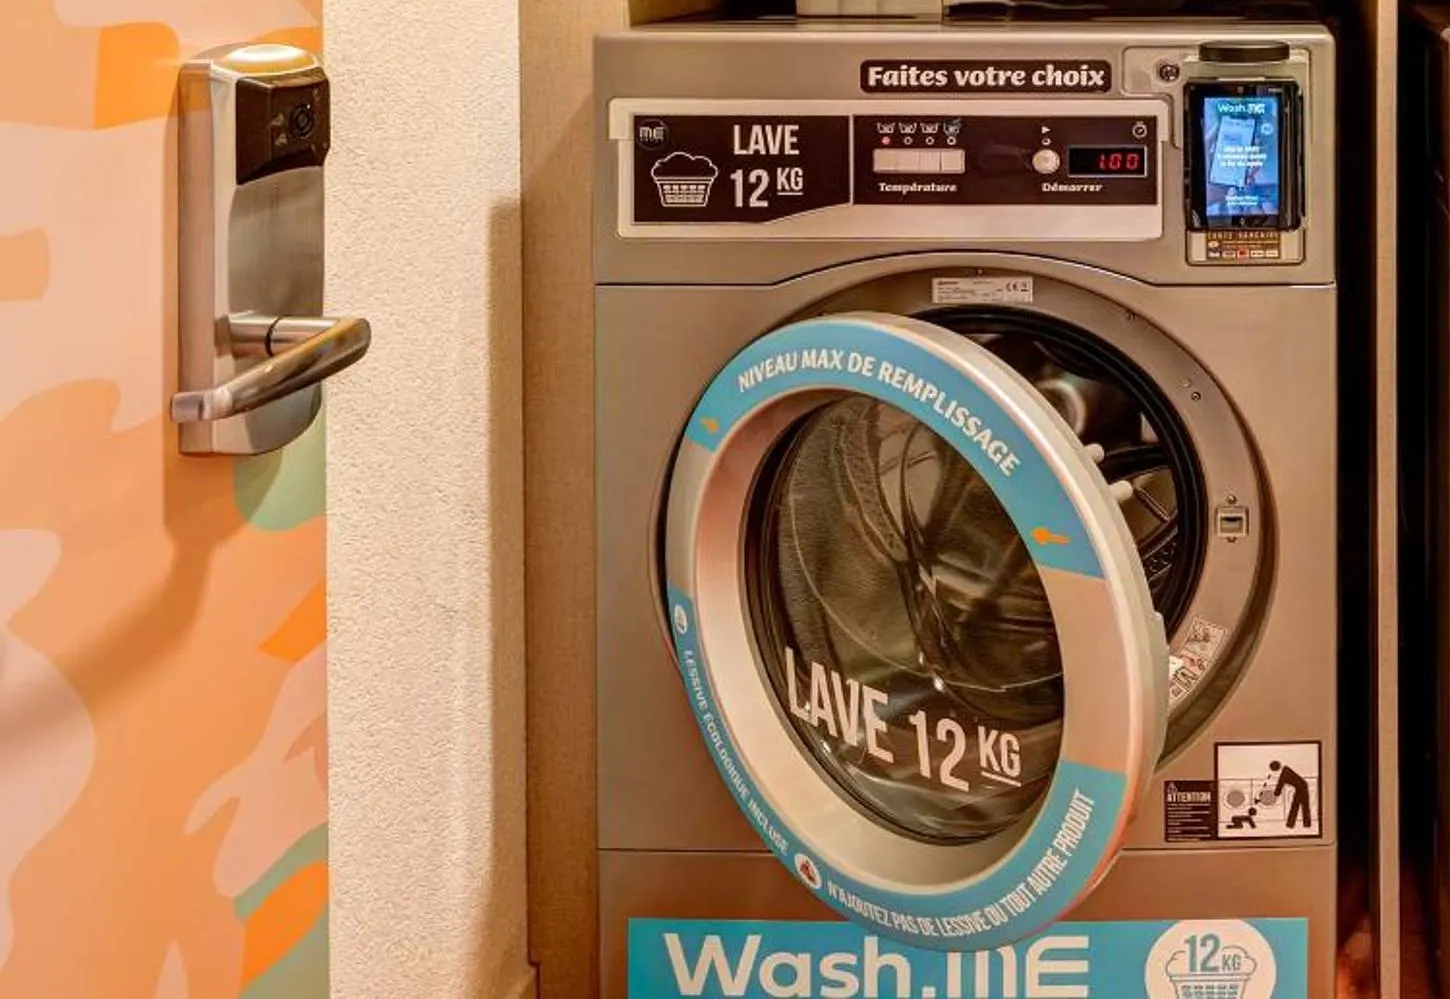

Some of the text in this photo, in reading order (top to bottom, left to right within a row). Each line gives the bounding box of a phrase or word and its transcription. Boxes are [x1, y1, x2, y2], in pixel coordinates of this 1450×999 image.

[868, 65, 1104, 86] Faites votre choix
[733, 124, 800, 155] LAVE
[730, 167, 804, 208] 12 KG
[878, 182, 958, 195] Température
[1041, 182, 1103, 193] Démarrer
[738, 349, 1021, 477] NIVEAU MAX DE REMPLISSAGE
[785, 646, 1022, 793] LAVE 12 KG
[890, 911, 920, 935] PAS
[918, 917, 941, 937] DE
[937, 911, 994, 938] LESSIVE
[1000, 883, 1038, 917] TOUT
[1027, 847, 1069, 897] AUTRE
[1053, 788, 1096, 857] PRODUIT
